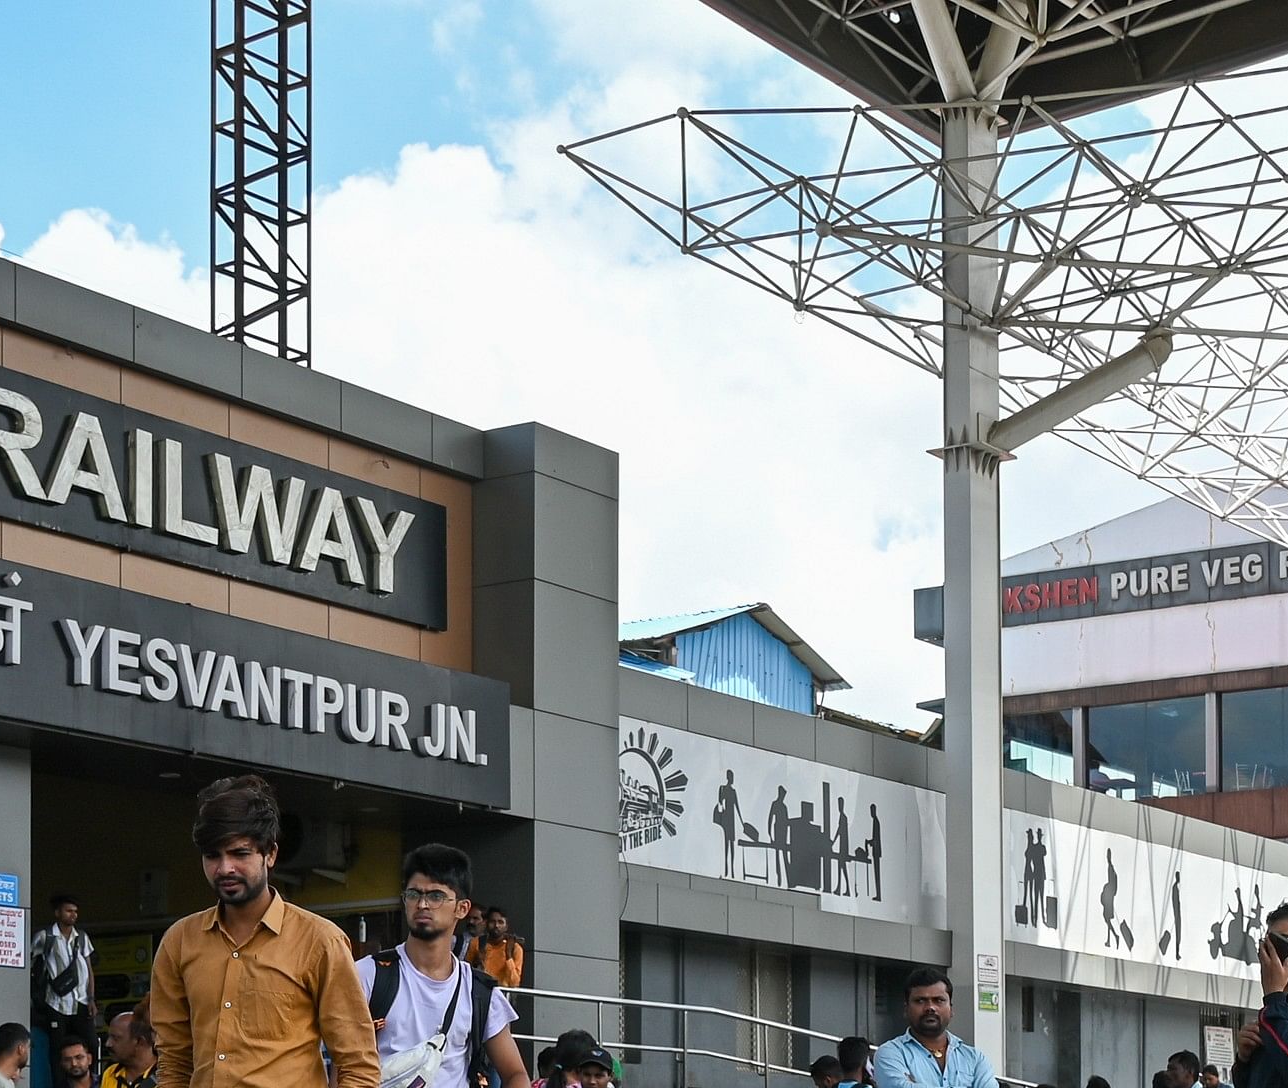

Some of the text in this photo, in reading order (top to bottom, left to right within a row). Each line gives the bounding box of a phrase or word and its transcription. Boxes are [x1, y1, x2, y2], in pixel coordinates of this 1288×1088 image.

[1111, 560, 1190, 601] PURE
[1200, 553, 1264, 587] VEG
[59, 617, 488, 766] YESVANTPUR JN.
[628, 830, 644, 851] THE
[644, 824, 662, 846] RIDE
